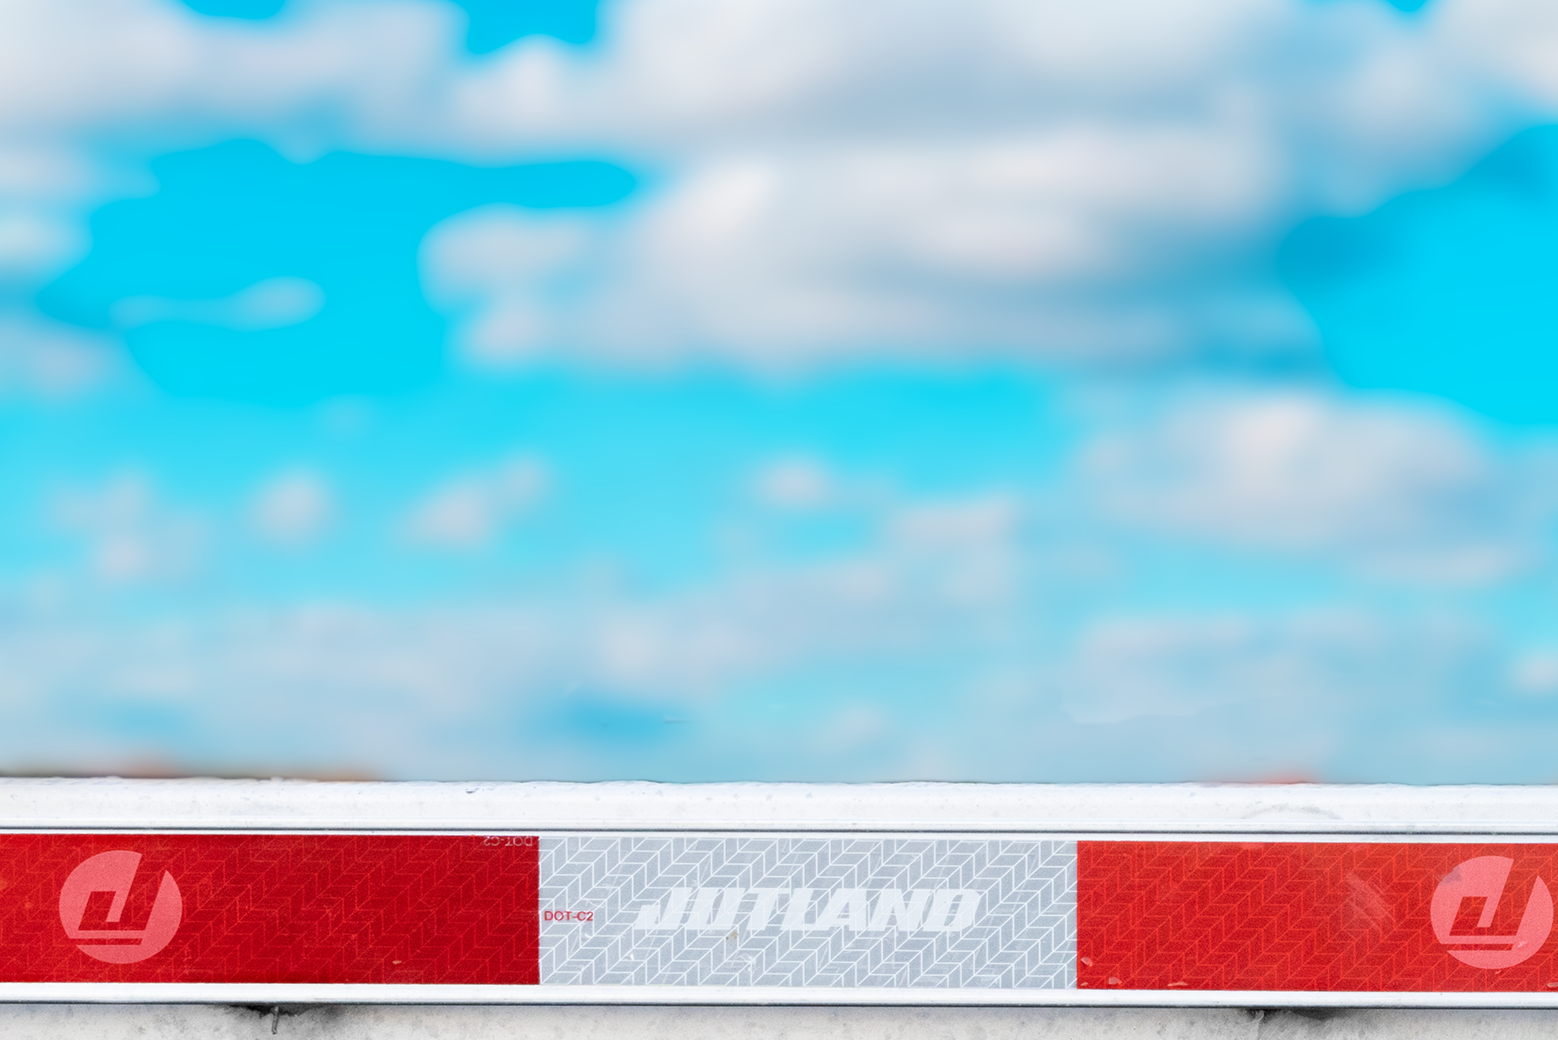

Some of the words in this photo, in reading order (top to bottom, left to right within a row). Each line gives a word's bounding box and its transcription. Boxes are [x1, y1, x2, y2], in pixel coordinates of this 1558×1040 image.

[483, 836, 533, 847] DOT-C2
[633, 887, 982, 932] JUTLAND
[543, 910, 594, 922] DOT-C2
